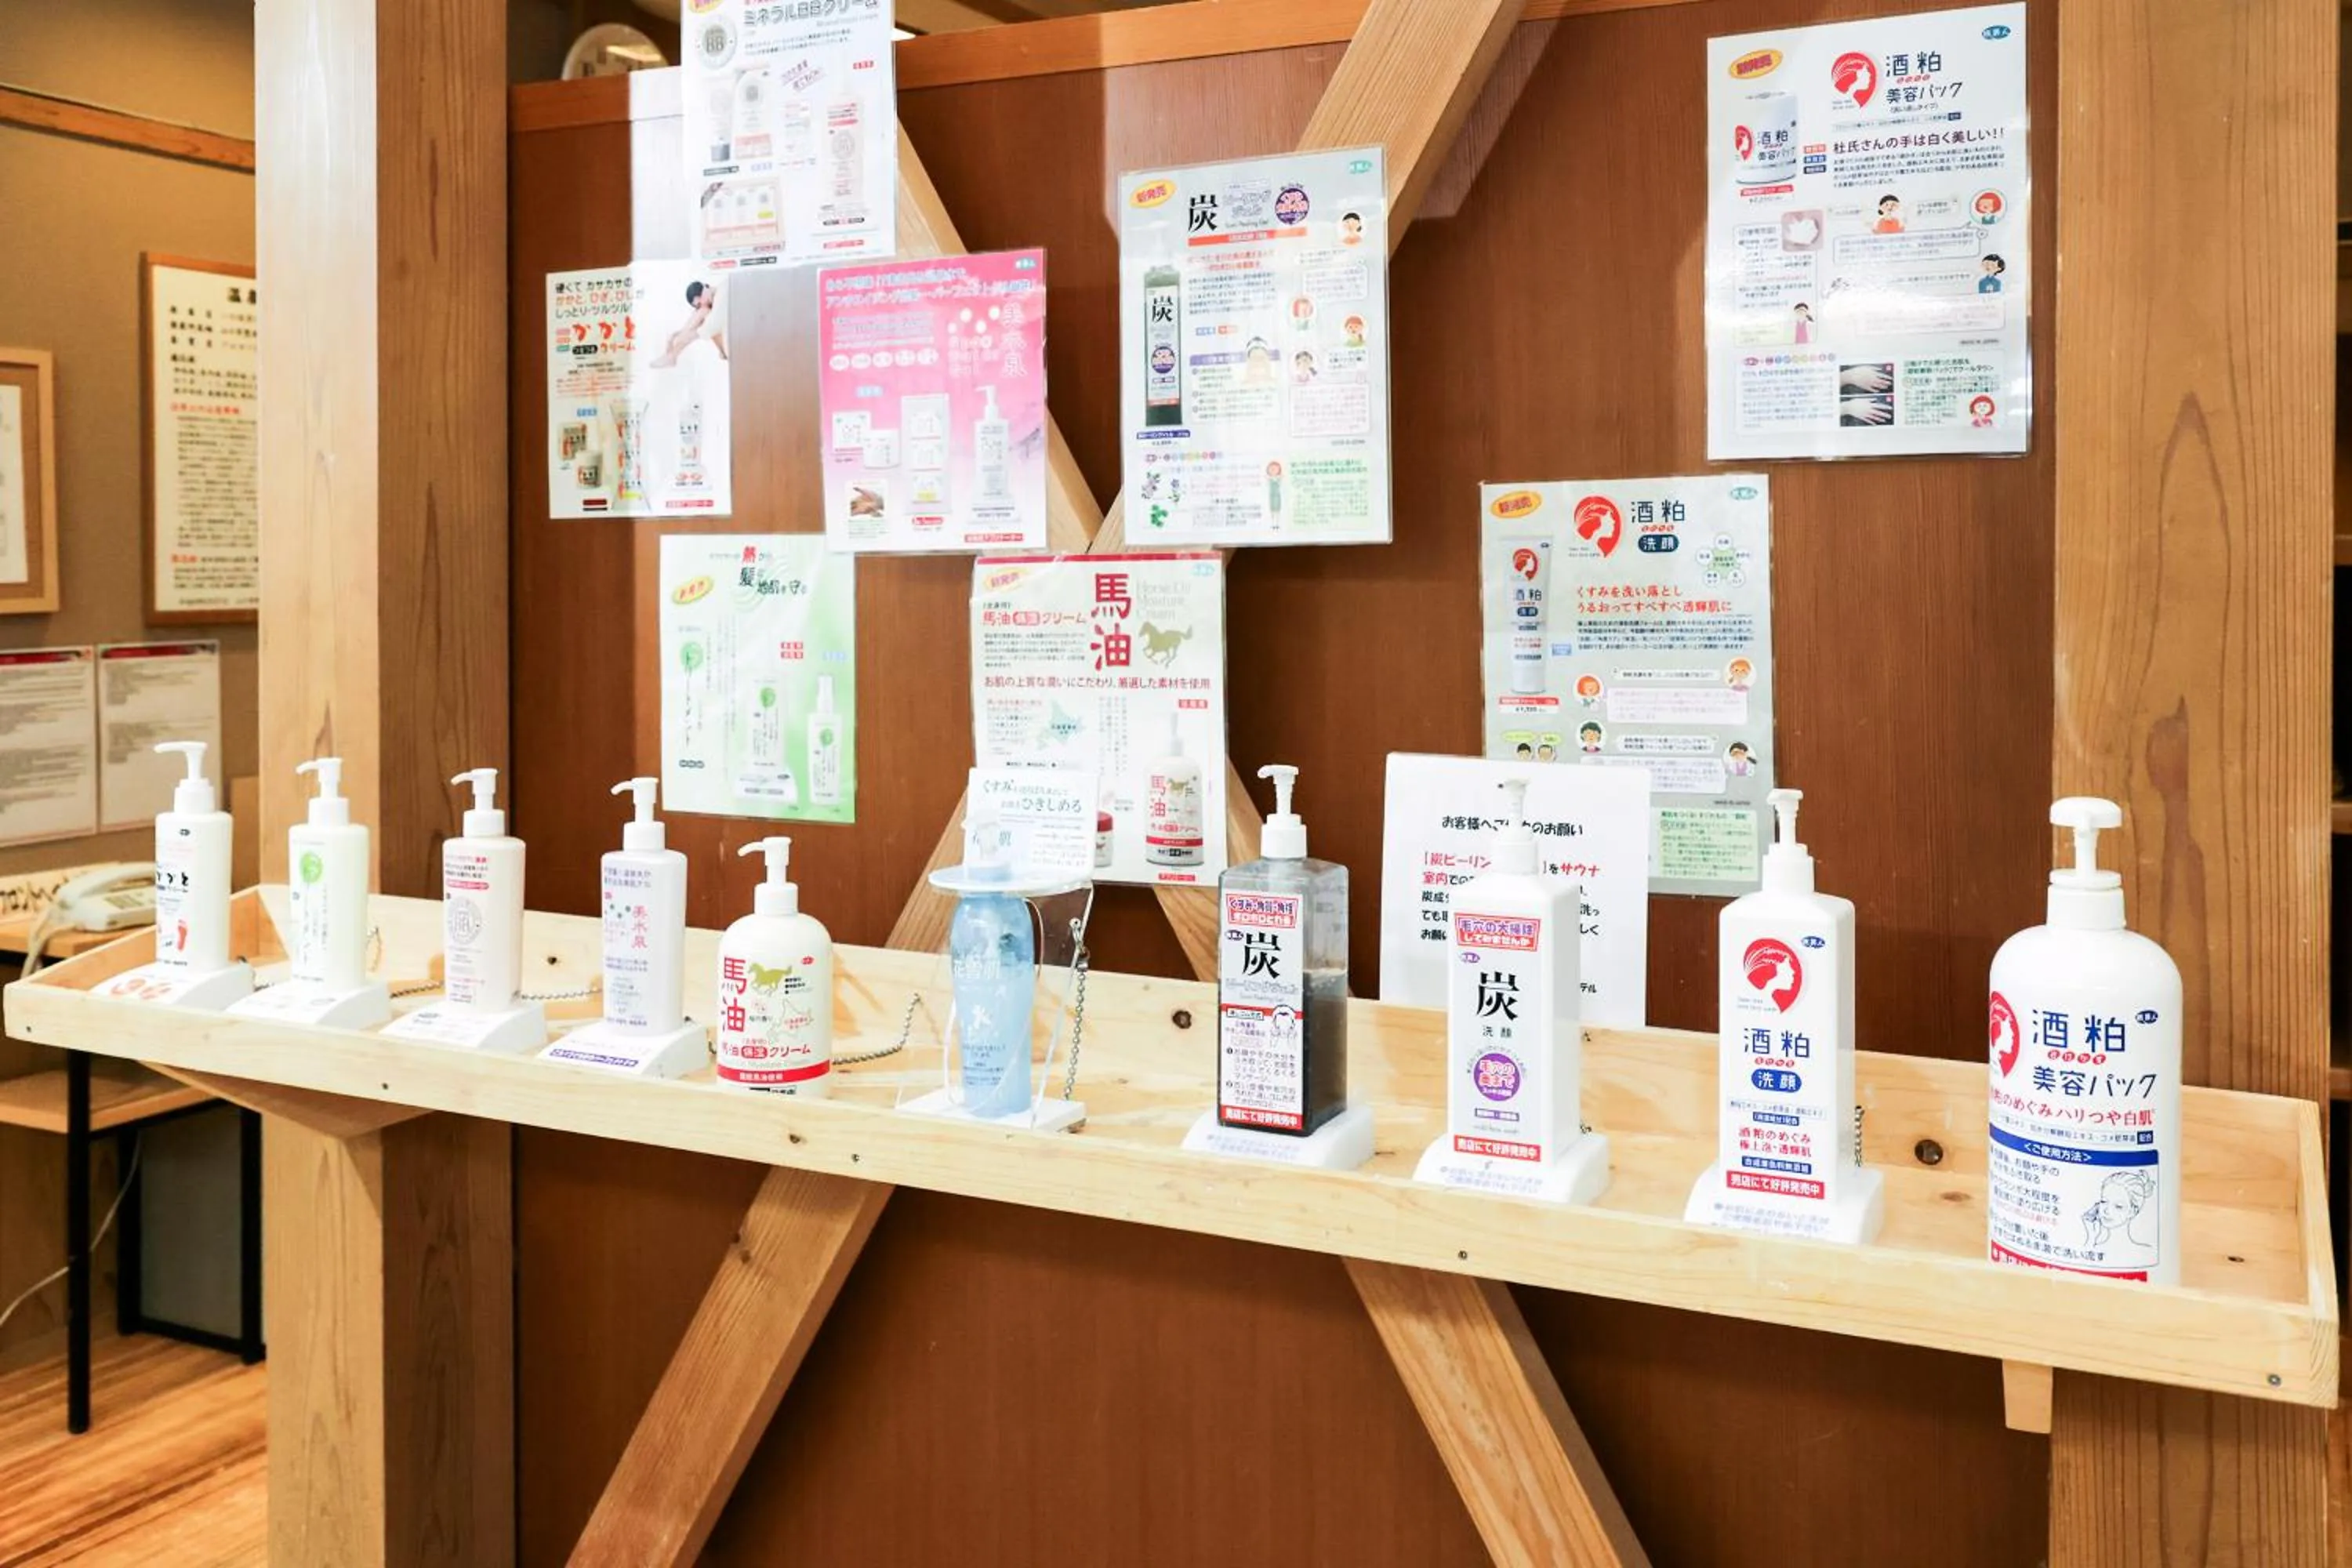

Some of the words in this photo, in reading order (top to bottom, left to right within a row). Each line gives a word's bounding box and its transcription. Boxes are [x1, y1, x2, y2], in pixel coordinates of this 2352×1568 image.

[1886, 51, 1941, 77] 酒粕
[1886, 82, 1963, 104] 美容パック
[1188, 194, 1218, 232] 炭
[1152, 296, 1173, 322] 炭
[1632, 499, 1686, 524] 酒粕
[1642, 536, 1675, 551] 洗顔
[1577, 585, 1682, 598] くすみを洗い落とし
[1577, 600, 1732, 615] うるおってすべすべ透輝肌に
[1091, 572, 1131, 671] 馬油
[985, 676, 1210, 689] お肌の上質な潤いにこだわり、厳選した素材を使用
[1442, 816, 1583, 837] お客様へごのお願い
[632, 906, 648, 949] 美水泉
[1461, 920, 1534, 935] 毛穴の大掃除
[1464, 933, 1530, 947] してみませんか
[1242, 931, 1281, 978] 炭
[721, 956, 746, 1033] 馬油
[1476, 971, 1520, 1022] 炭
[1483, 1025, 1512, 1038] 洗顔
[2032, 1009, 2125, 1052] 酒粕
[1744, 1028, 1809, 1058] 酒粕
[1757, 1071, 1797, 1091] 洗顔
[2033, 1065, 2157, 1098] 美容パック
[1739, 1127, 1810, 1143] 酒粕のめぐみ
[1457, 1137, 1537, 1160] 売店にて好評発売中
[1730, 1175, 1820, 1195] 売店にて好評発売中
